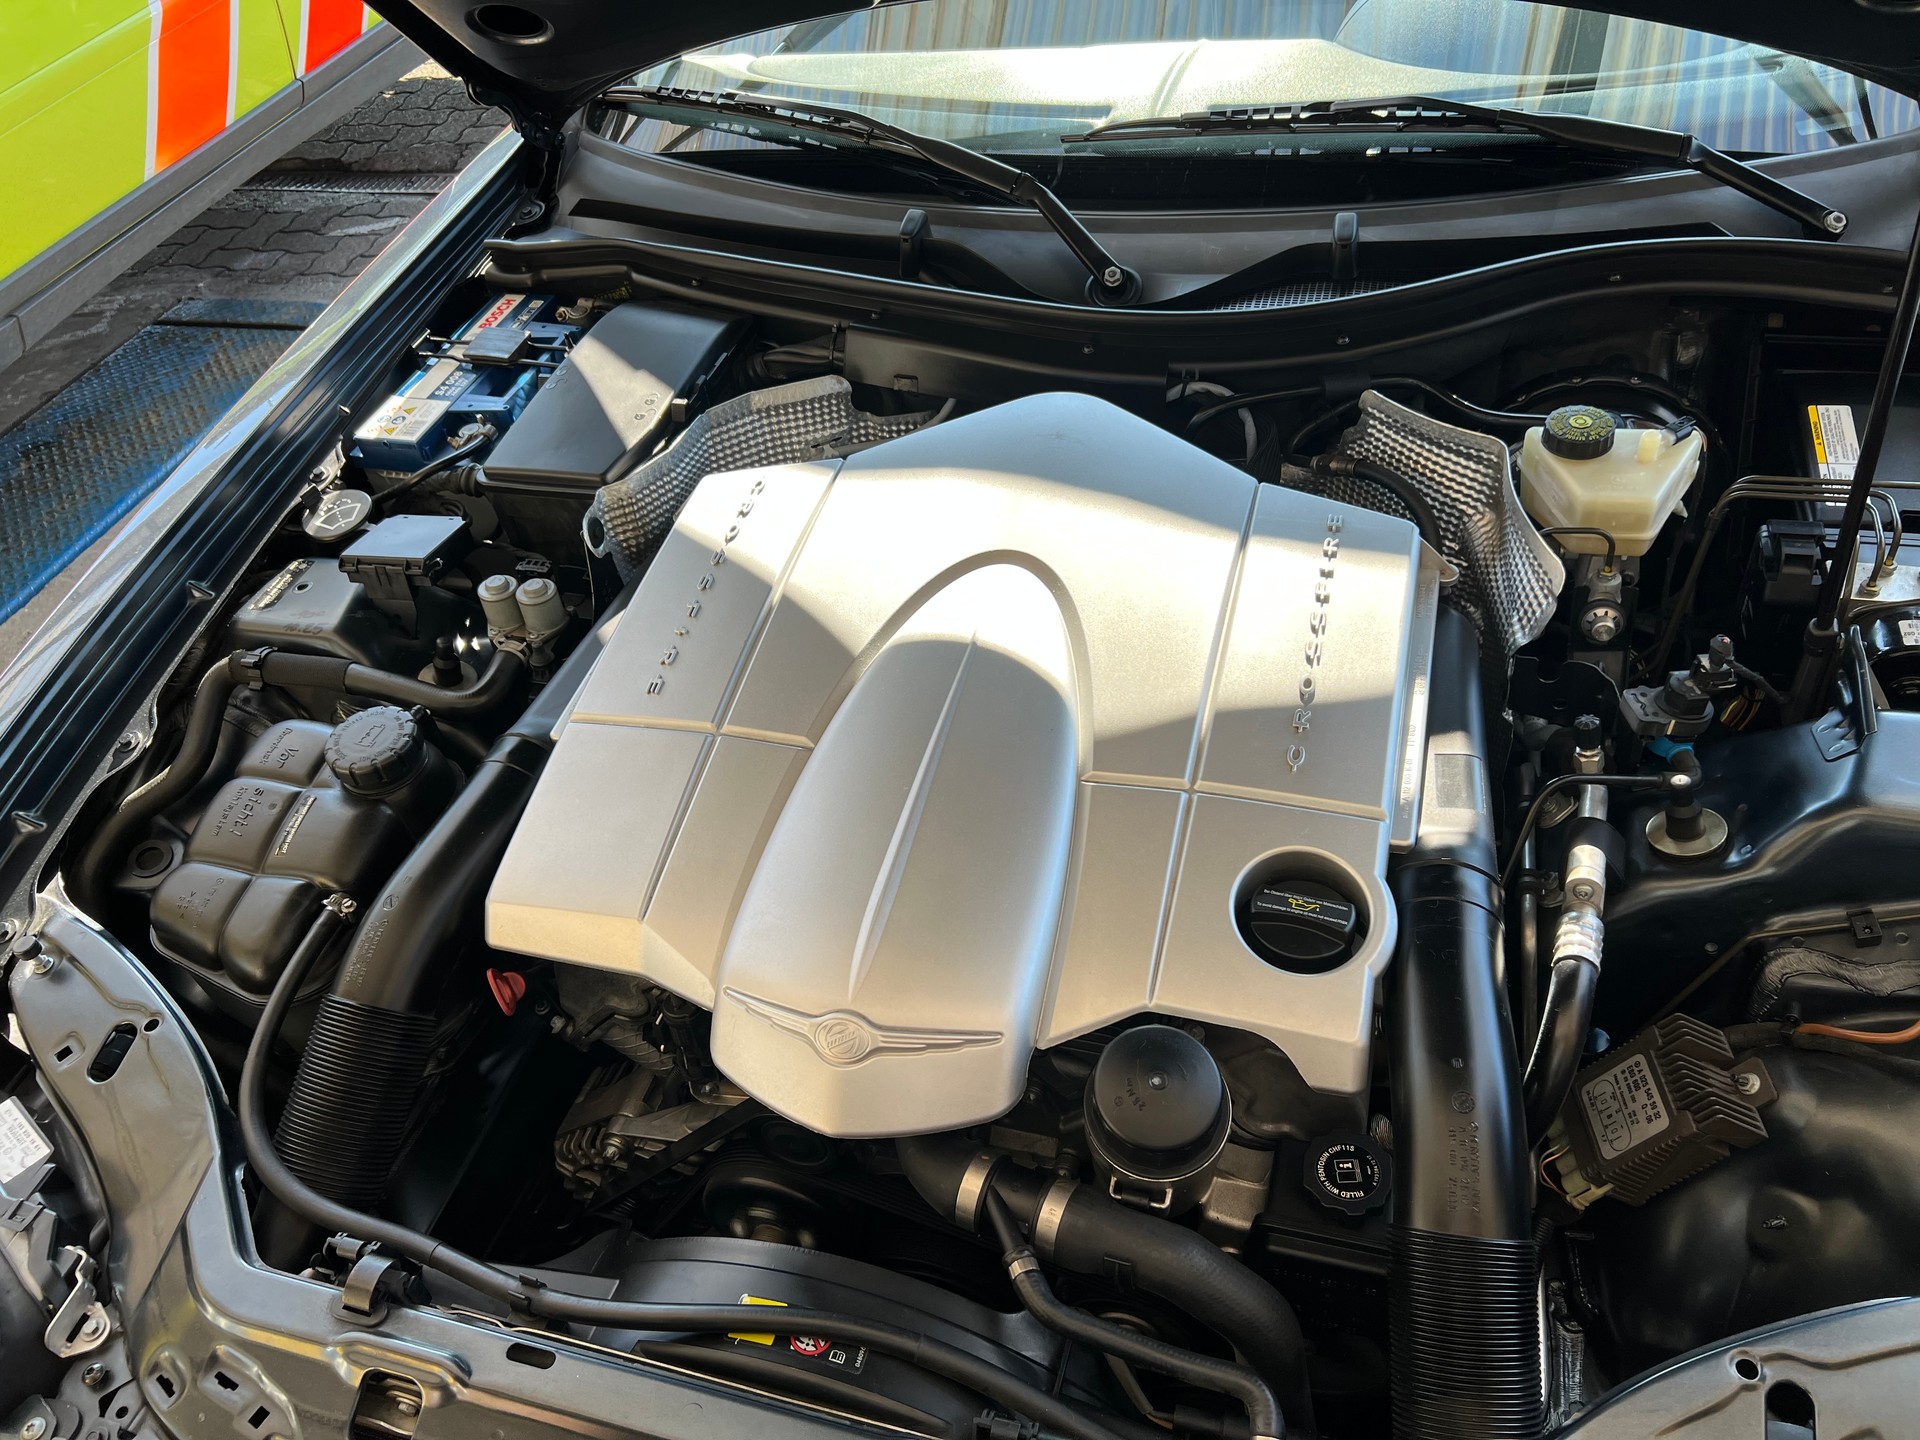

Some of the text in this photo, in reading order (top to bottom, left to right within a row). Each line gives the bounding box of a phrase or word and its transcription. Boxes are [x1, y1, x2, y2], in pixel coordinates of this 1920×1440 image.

[478, 298, 517, 329] BOSCH
[1287, 513, 1343, 773] CROSSFIRE
[1640, 1075, 1649, 1087] 025
[1317, 1151, 1330, 1181] PENTOSIN
[1324, 1181, 1339, 1195] WITH
[1340, 1190, 1364, 1198] FILLED
